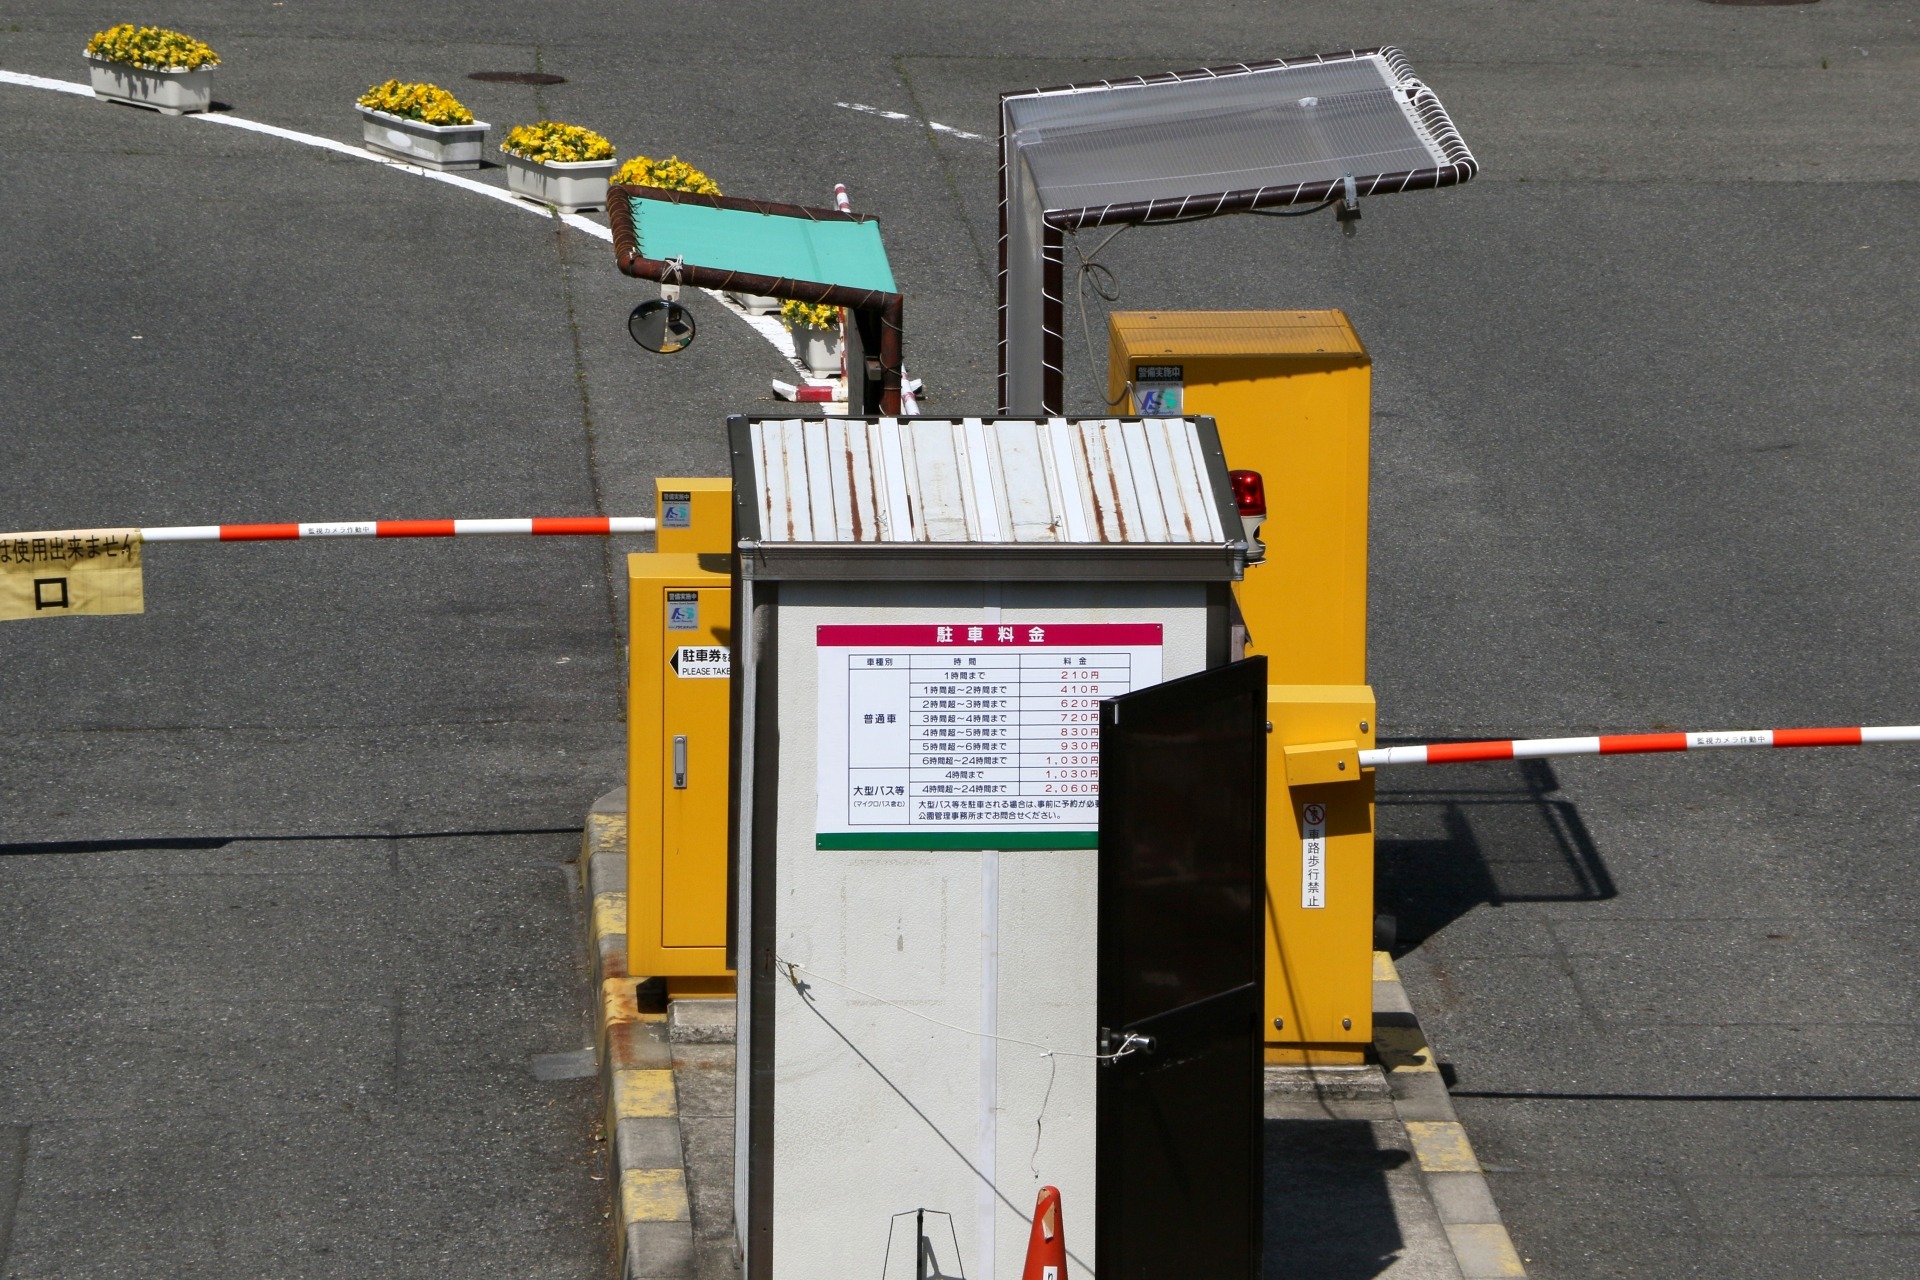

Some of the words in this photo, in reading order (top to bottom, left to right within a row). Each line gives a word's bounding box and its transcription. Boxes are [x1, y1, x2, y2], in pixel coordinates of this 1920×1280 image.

[308, 524, 371, 536] 監視カメラ作動中
[682, 649, 730, 662] 駐車券を
[866, 657, 894, 667] 車種別
[682, 668, 711, 676] PLEASE
[713, 668, 730, 676] TAKE
[944, 671, 986, 680] 1時間まで
[1060, 670, 1099, 680] 210円
[1060, 685, 1099, 694] 410円
[1060, 699, 1099, 708] 620円
[863, 713, 897, 725] 普通車
[1060, 713, 1099, 722] 720円
[1060, 727, 1099, 737] 830円
[1060, 741, 1099, 751] 930円
[1696, 736, 1766, 746] 監視カメラ作動中
[1045, 755, 1099, 766] 1,030円
[944, 770, 984, 780] 4時間まで
[1045, 769, 1099, 780] 1,030円
[853, 785, 905, 797] 大型バス等
[1044, 783, 1099, 794] 2,060円
[1308, 829, 1320, 907] 車路歩行禁止
